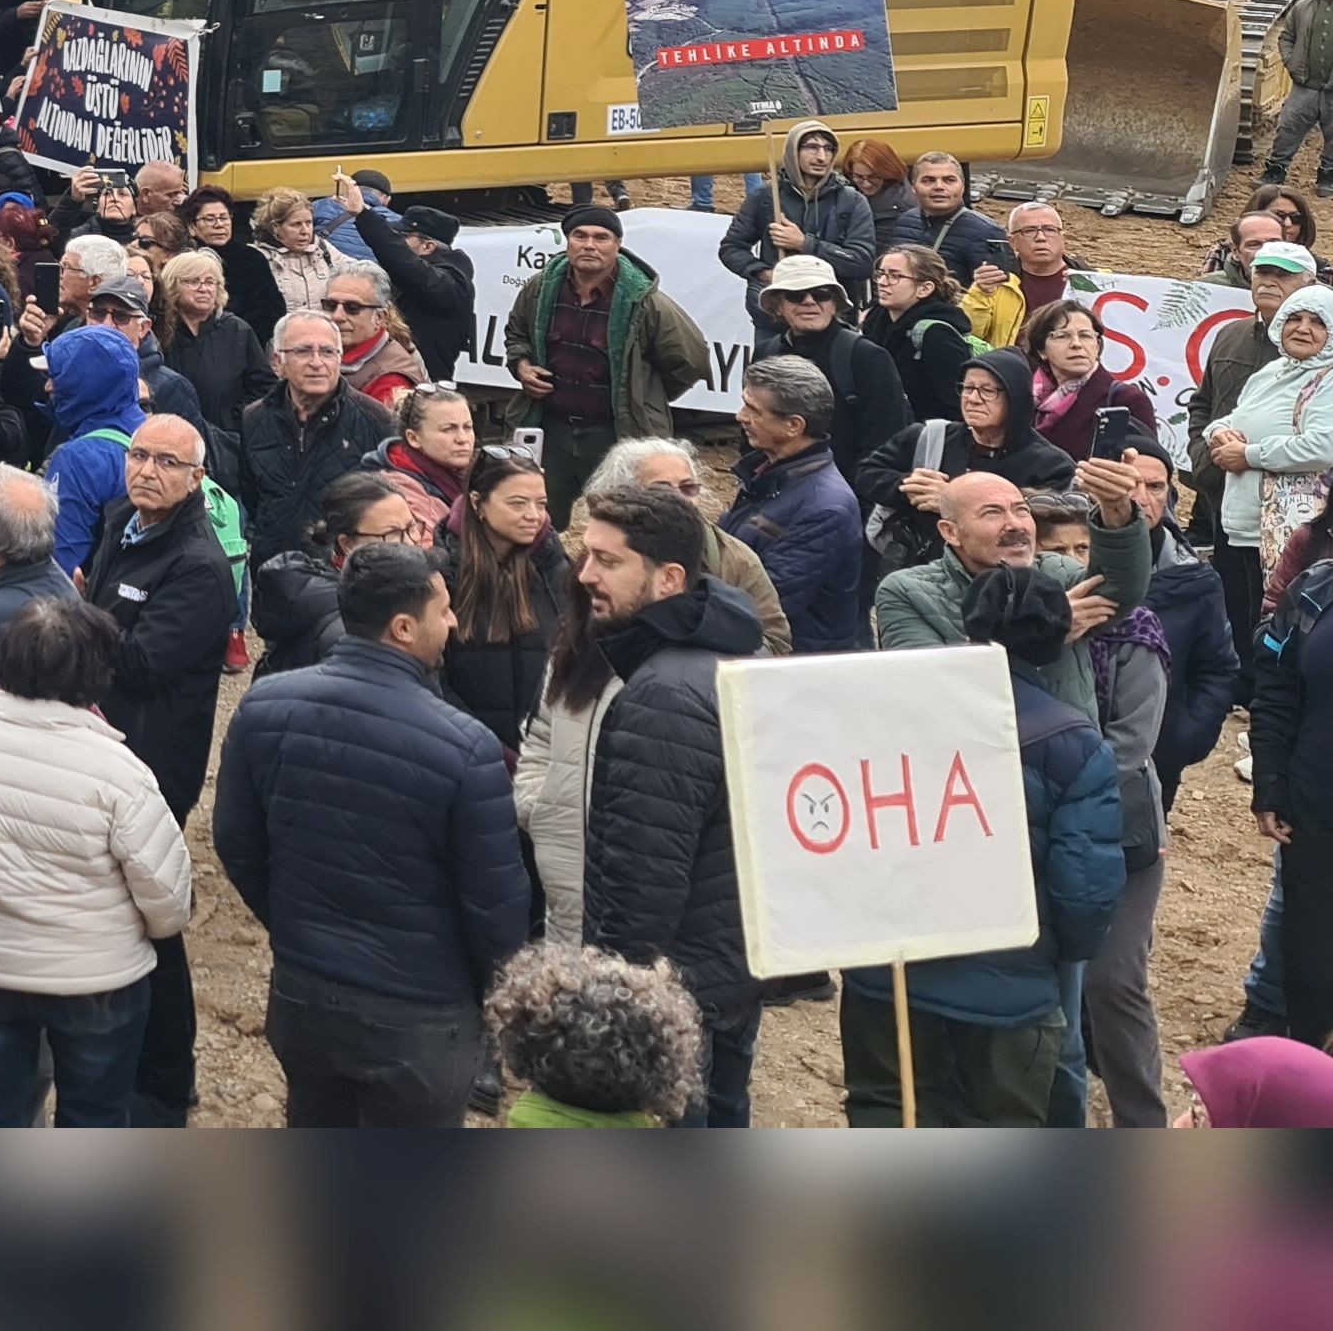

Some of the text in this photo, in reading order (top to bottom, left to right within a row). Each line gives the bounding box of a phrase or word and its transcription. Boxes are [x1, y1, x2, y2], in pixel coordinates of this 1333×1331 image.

[63, 32, 154, 92] KAZDAĞLARININ
[660, 33, 862, 65] TEHLİKE ALTINDA
[85, 74, 120, 119] ÜSTÜ
[751, 101, 775, 110] TEMA
[35, 96, 175, 165] ALTINDAN DEĞERLİDİR
[786, 749, 994, 855] OHA
